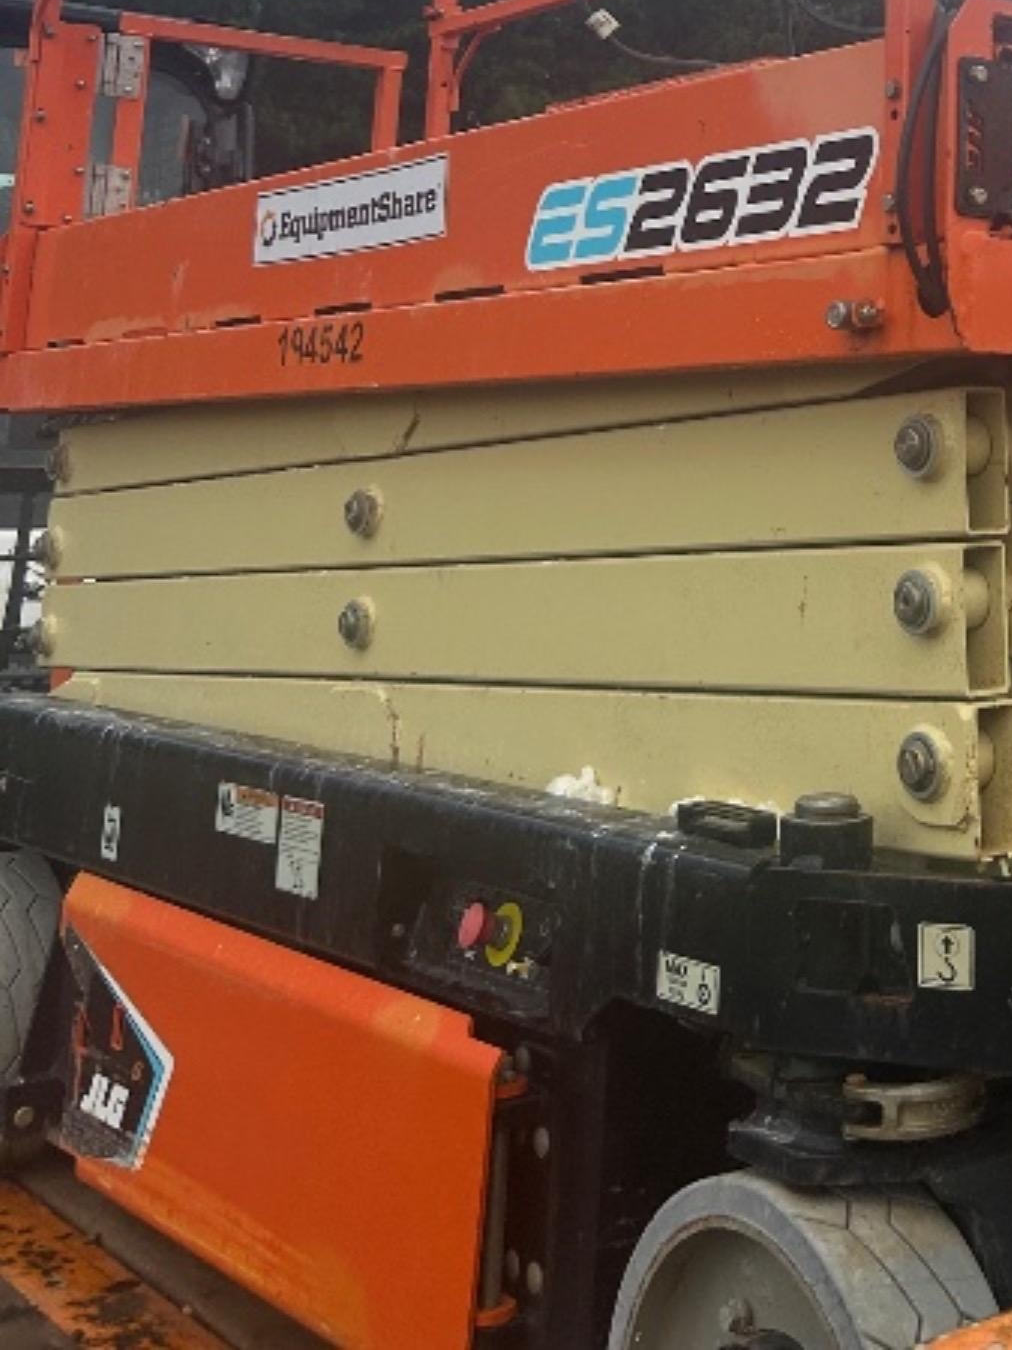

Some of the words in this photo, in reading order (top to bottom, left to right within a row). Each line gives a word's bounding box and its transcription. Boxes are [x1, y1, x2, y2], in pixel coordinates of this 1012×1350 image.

[279, 188, 436, 243] EquipmentShare
[524, 127, 879, 271] ES2632
[278, 321, 364, 366] 194542
